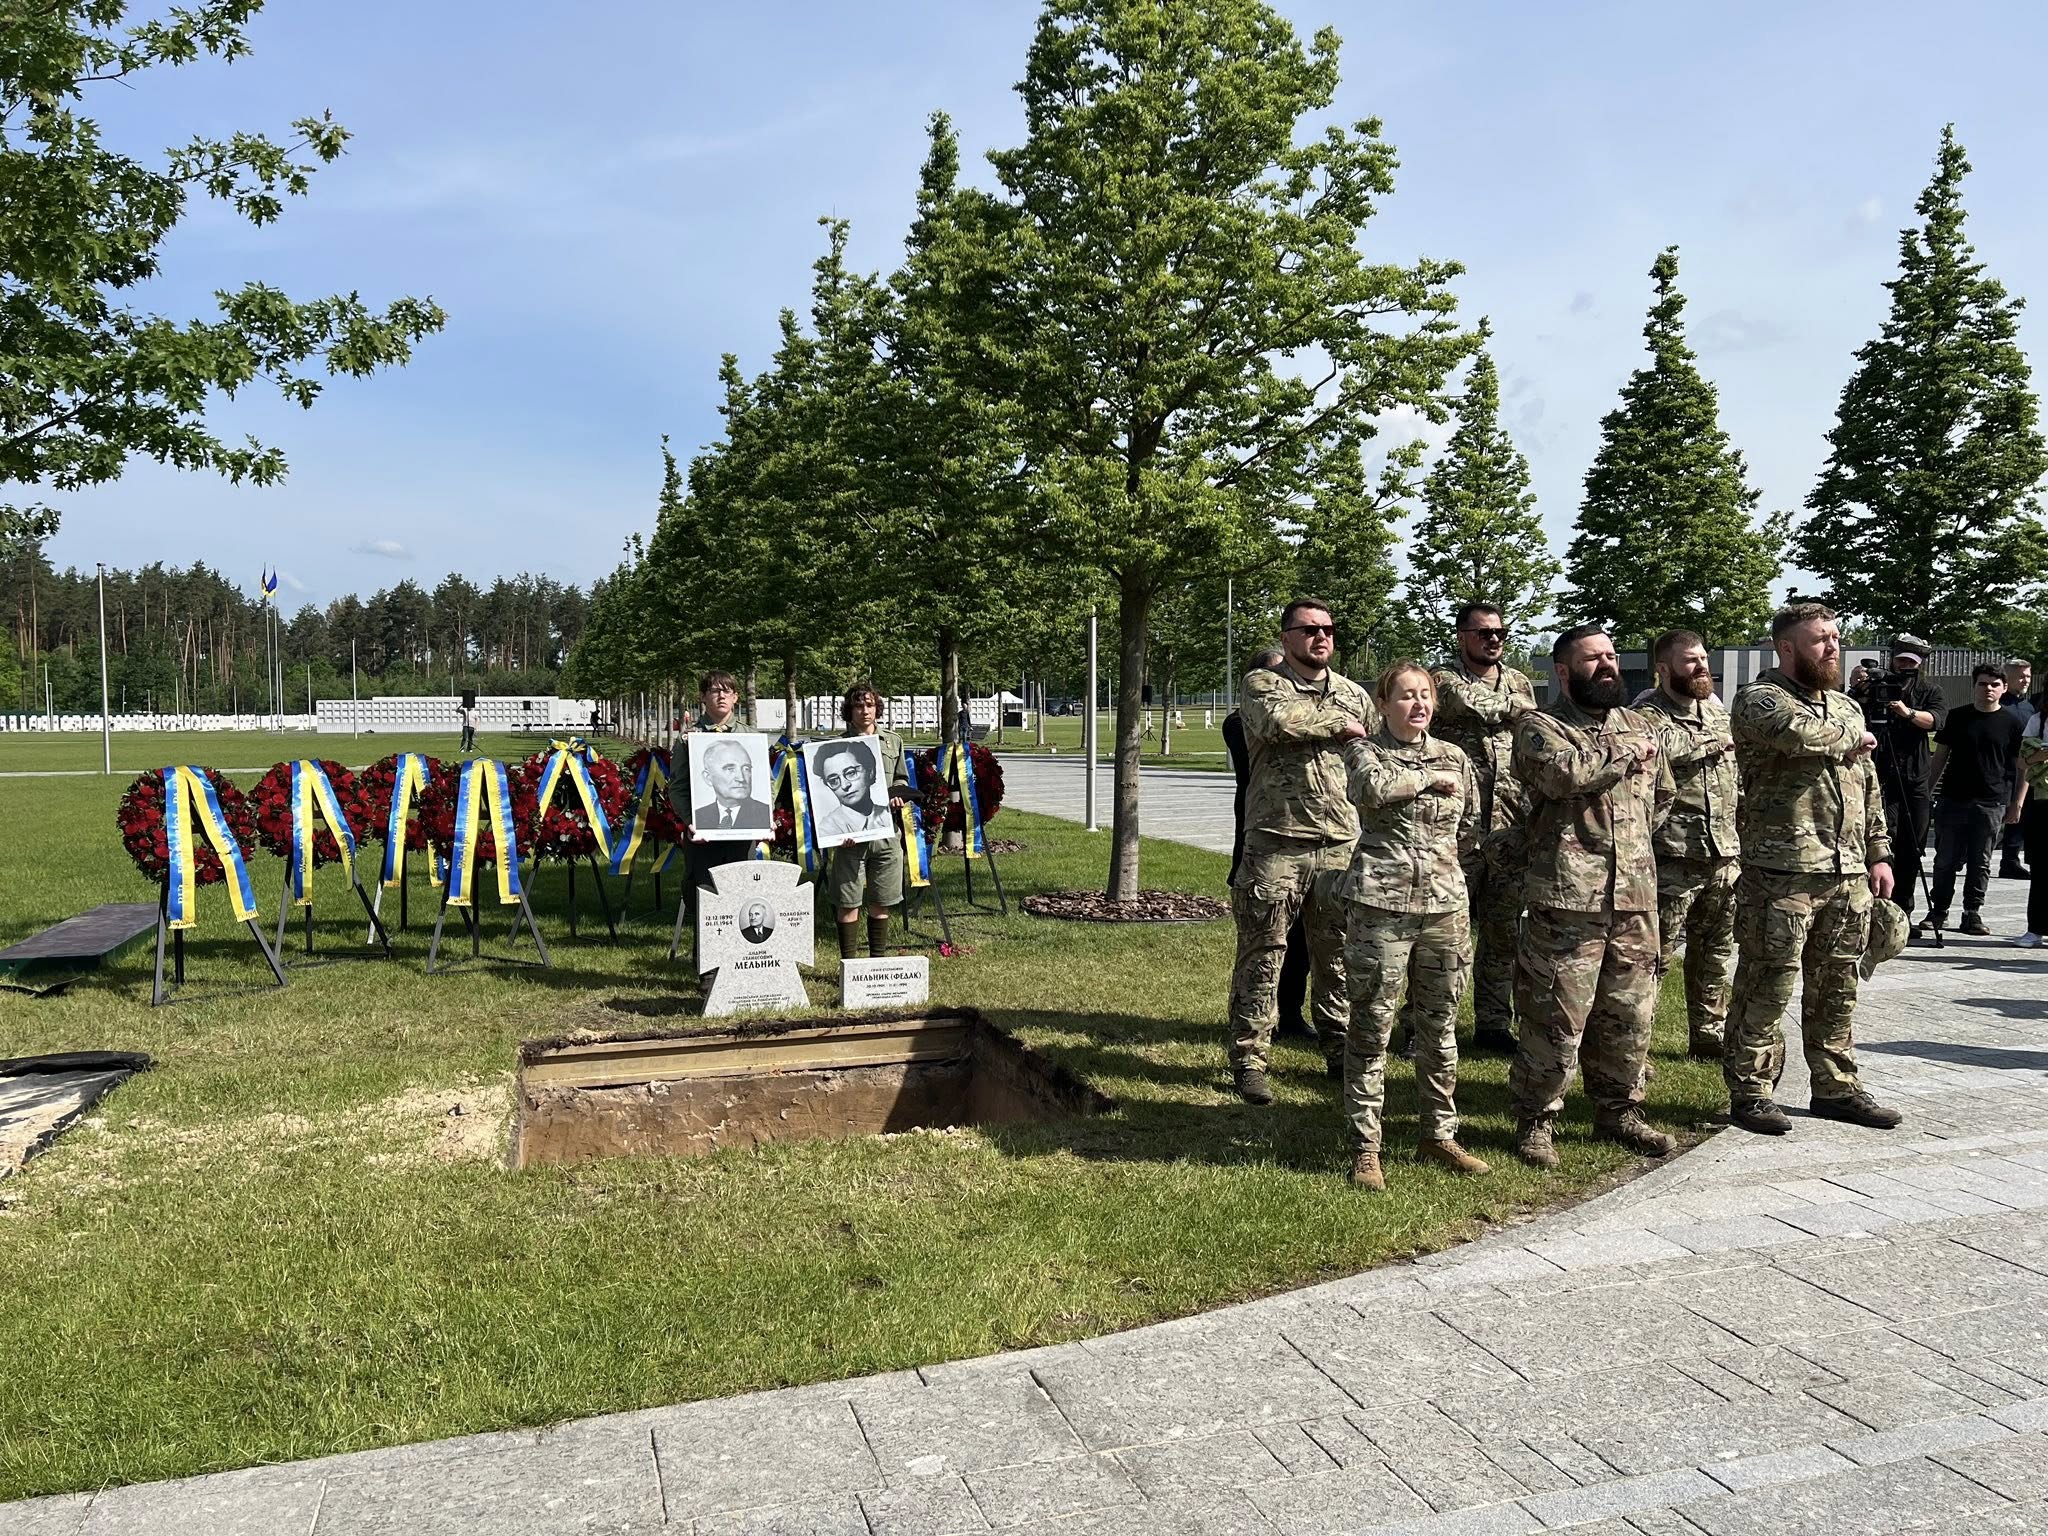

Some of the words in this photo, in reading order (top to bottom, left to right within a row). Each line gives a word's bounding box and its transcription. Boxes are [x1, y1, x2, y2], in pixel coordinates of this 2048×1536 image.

[734, 959, 781, 970] МЕЛЬНИК
[851, 973, 889, 982] МЕЛЬНИК
[890, 970, 922, 980] (ФЕДАК)
